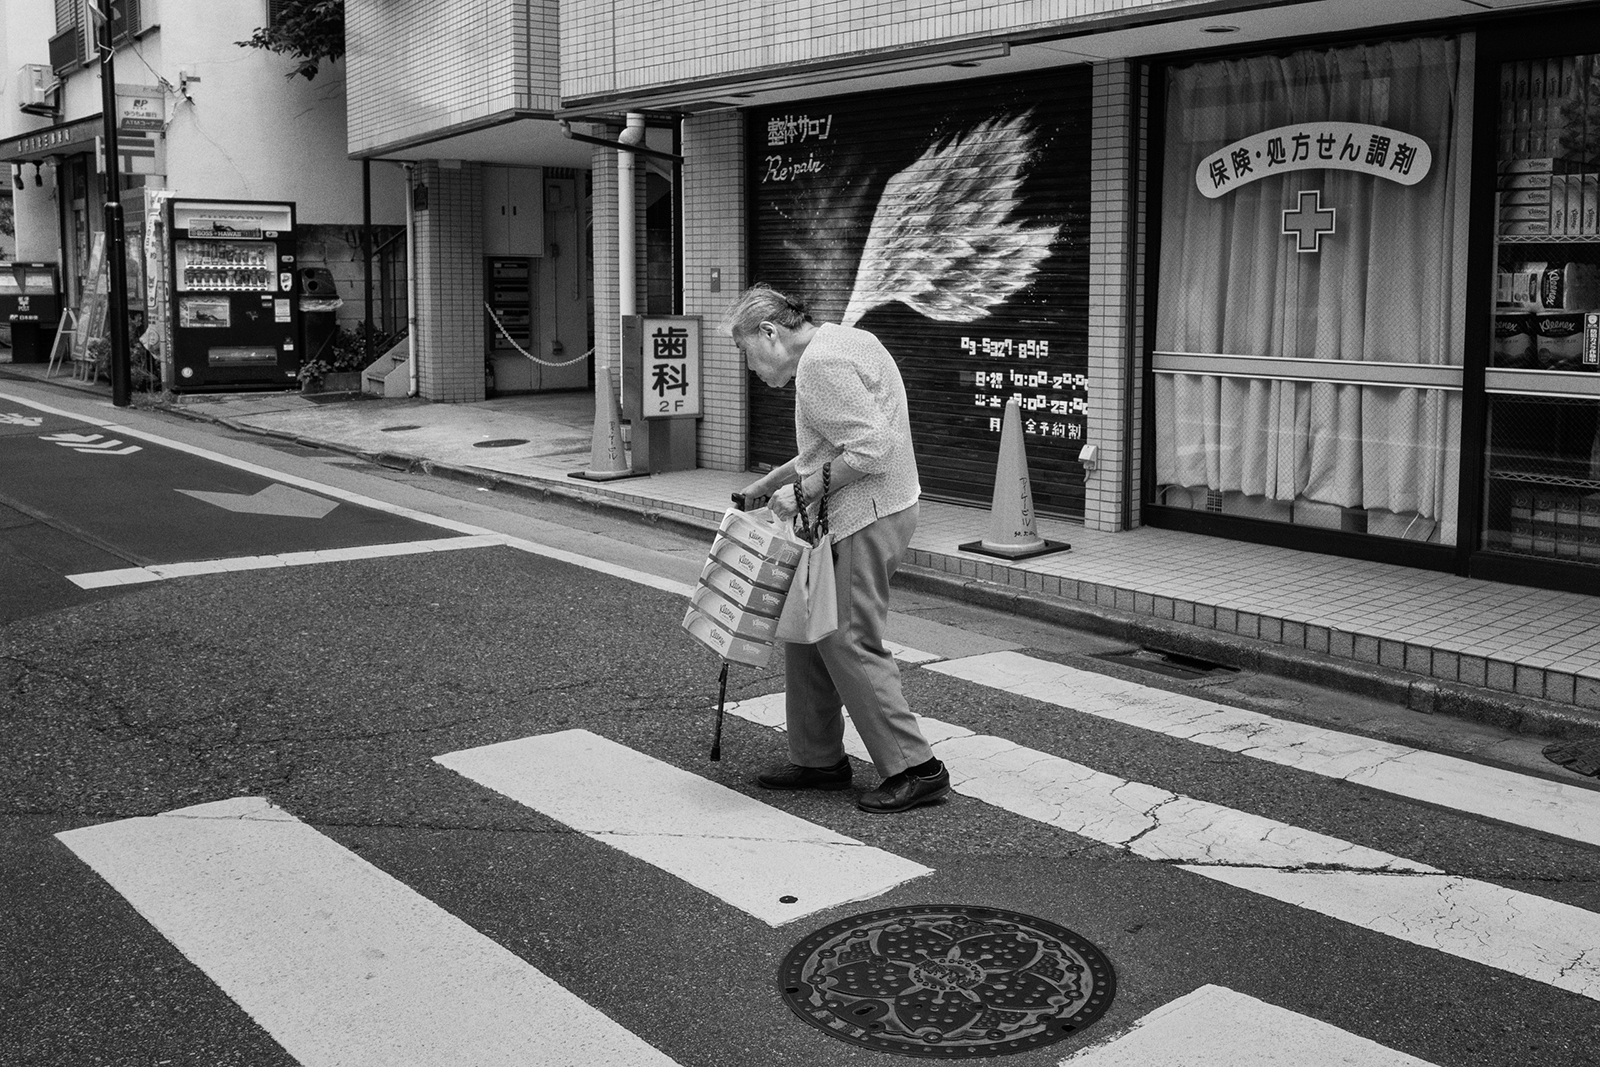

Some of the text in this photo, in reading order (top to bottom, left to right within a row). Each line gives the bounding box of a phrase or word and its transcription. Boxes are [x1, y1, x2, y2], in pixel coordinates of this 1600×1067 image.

[768, 114, 832, 146] 整体サロン
[1208, 131, 1418, 189] 保険・処方せん調剤
[1546, 269, 1560, 306] Kleenex
[1539, 318, 1575, 333] Kleenex
[652, 326, 689, 398] 歯科
[961, 337, 1049, 359] 03-5327-8915
[659, 400, 684, 413] 2F
